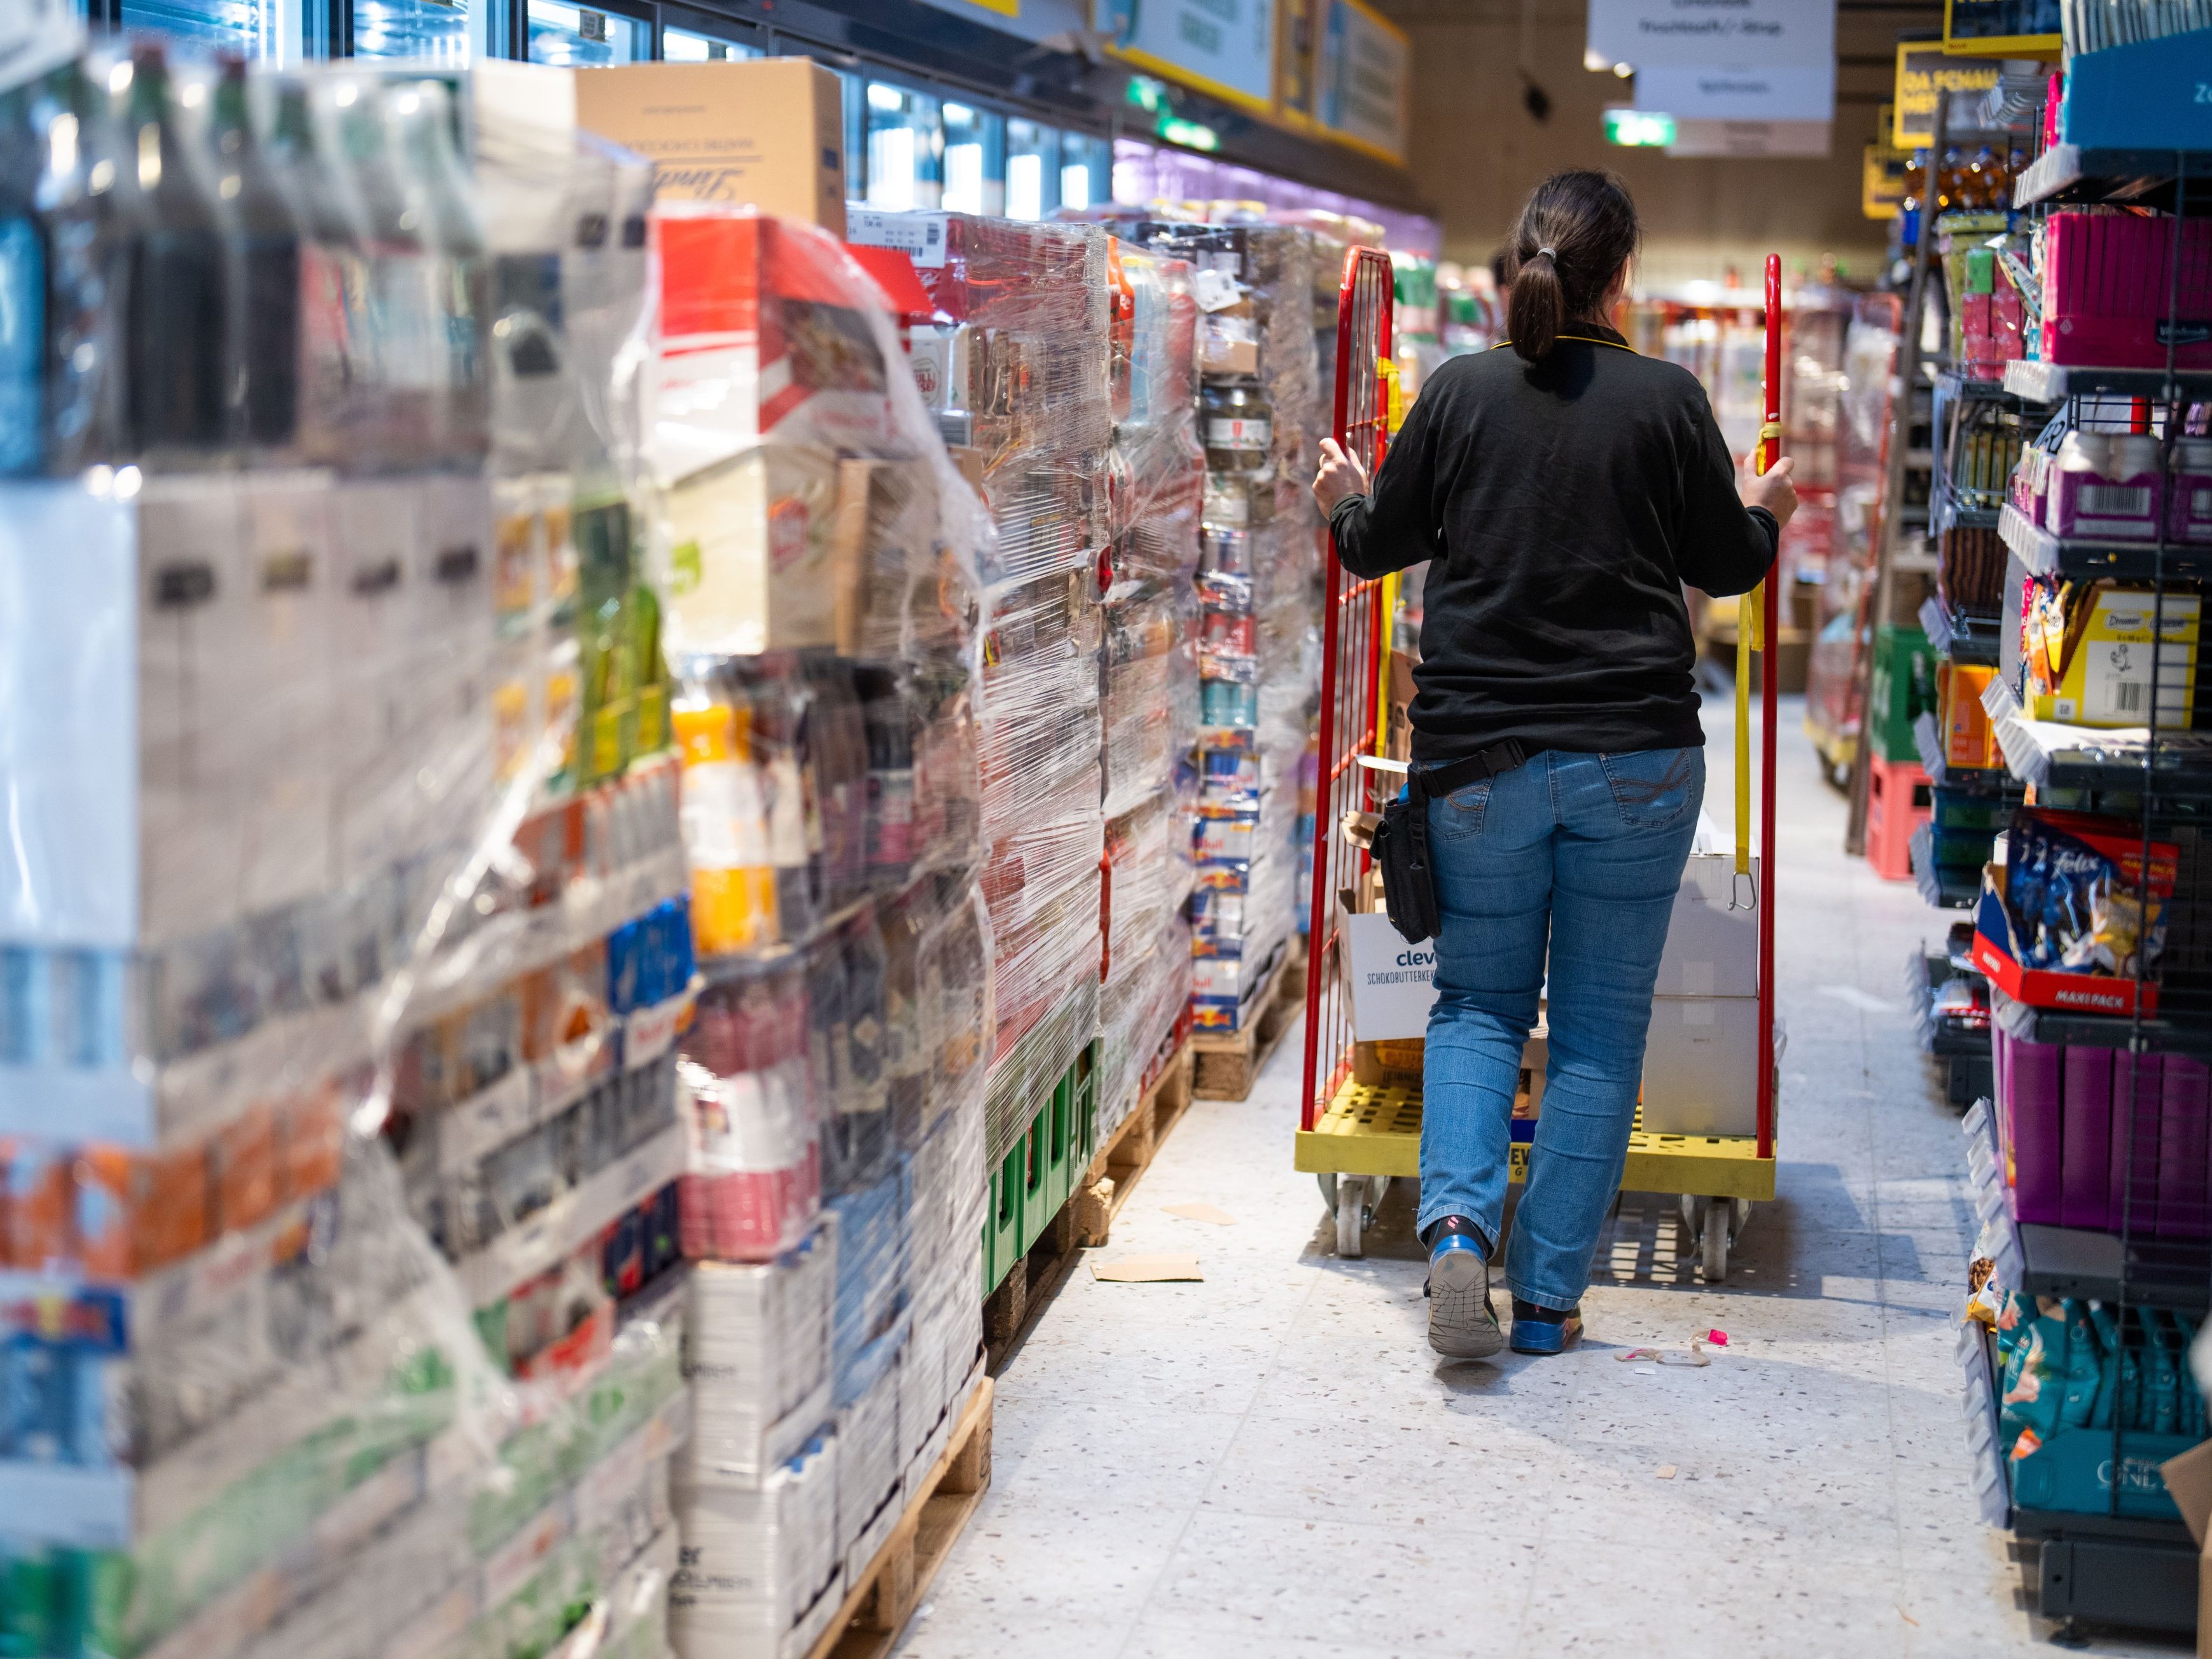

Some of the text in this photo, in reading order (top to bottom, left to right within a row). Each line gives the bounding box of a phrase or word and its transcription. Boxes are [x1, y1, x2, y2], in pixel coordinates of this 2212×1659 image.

[1396, 950, 1436, 967] clev
[1367, 969, 1435, 985] SCHOKOBUTTERKEK
[2055, 989, 2125, 1009] MAXI PACK
